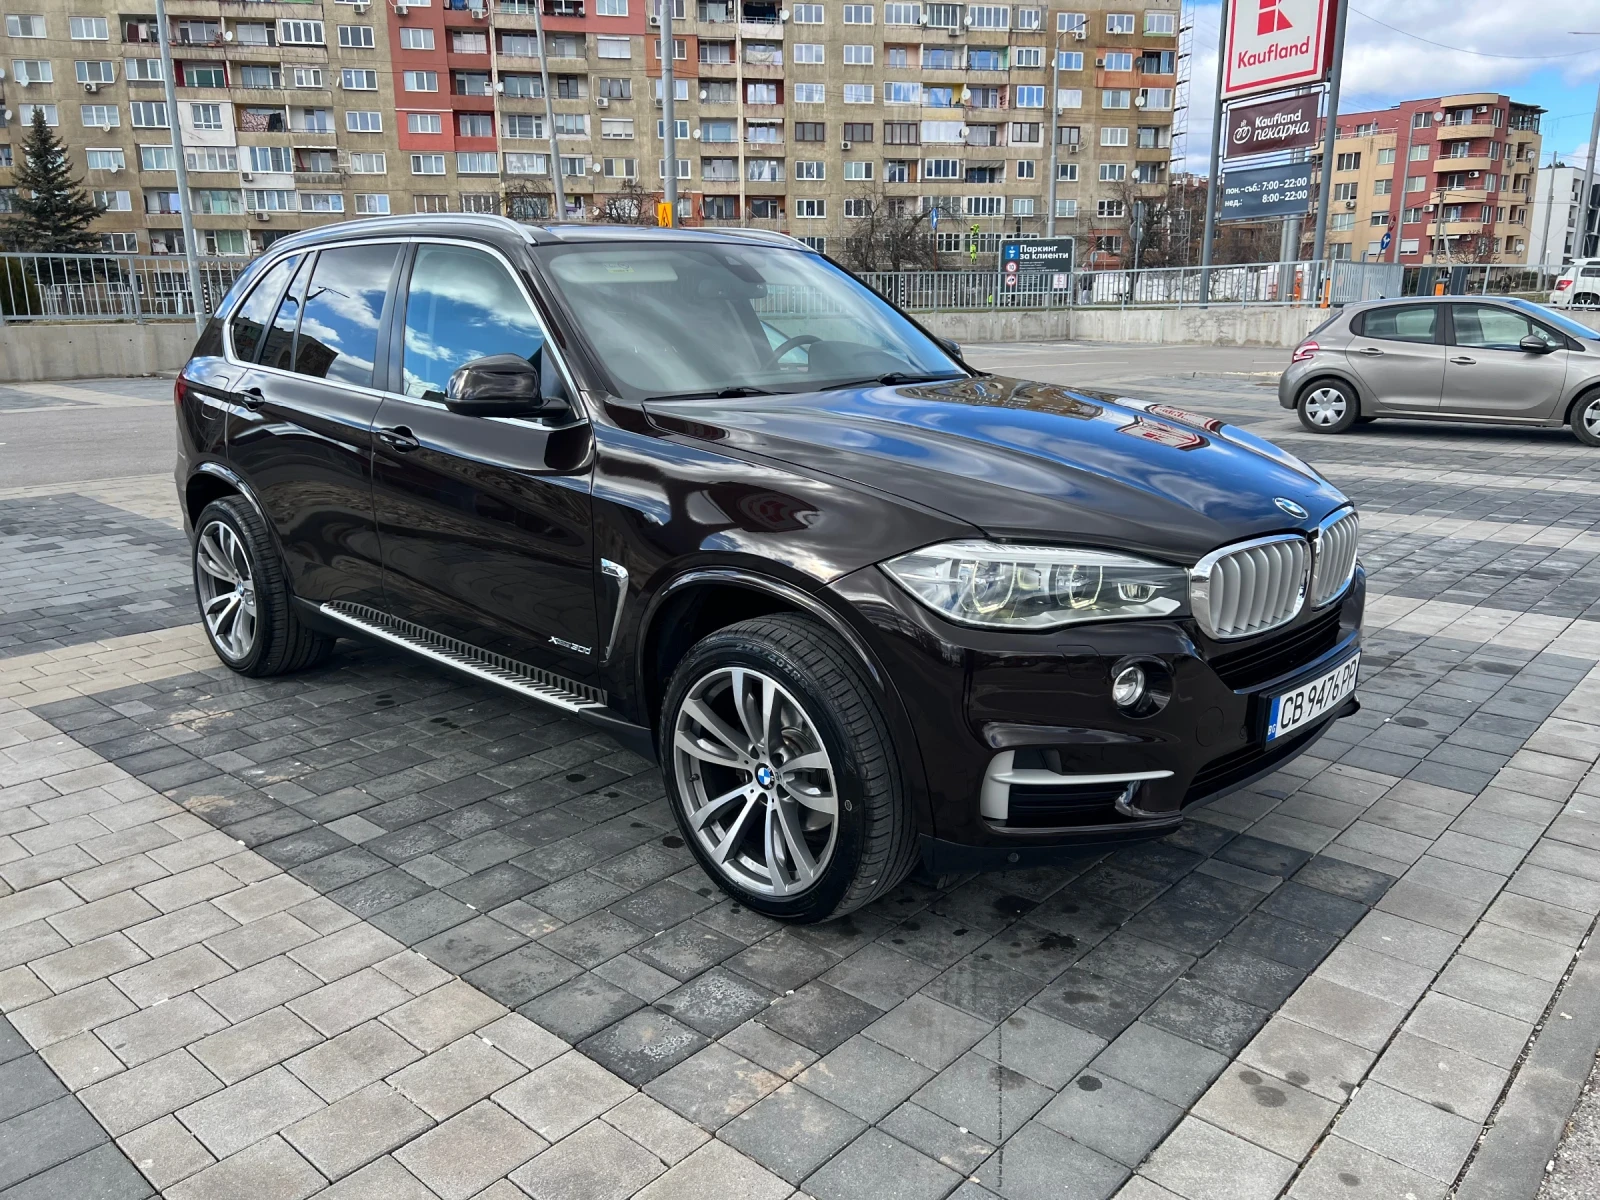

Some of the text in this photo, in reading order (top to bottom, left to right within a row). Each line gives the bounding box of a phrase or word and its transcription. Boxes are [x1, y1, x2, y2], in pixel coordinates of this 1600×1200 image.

[1238, 35, 1310, 69] Kaufland
[1255, 109, 1302, 128] Kaufland
[1253, 121, 1310, 141] пекарна
[1224, 199, 1243, 207] нед.:
[1019, 244, 1058, 254] Паркинг
[1281, 659, 1357, 729] CB 9476 PP
[1268, 724, 1276, 735] BG
